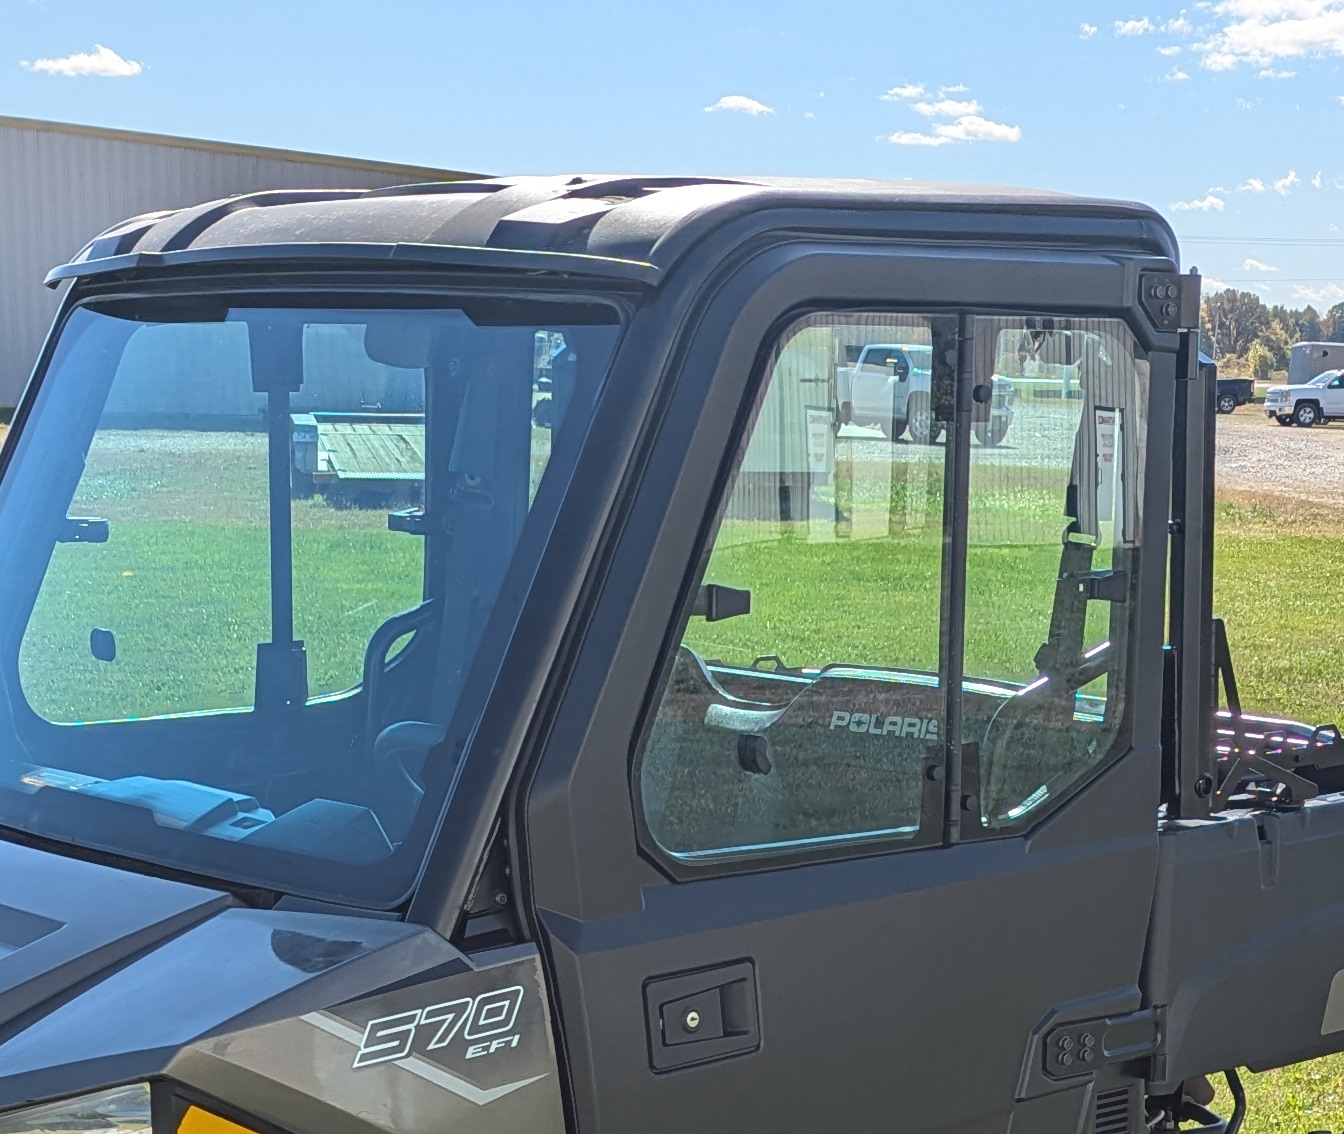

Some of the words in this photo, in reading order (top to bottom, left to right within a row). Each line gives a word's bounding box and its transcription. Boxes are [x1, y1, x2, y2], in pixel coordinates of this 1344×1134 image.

[829, 710, 938, 740] POLARIS
[352, 985, 524, 1069] 570
[465, 1034, 521, 1060] EFI
